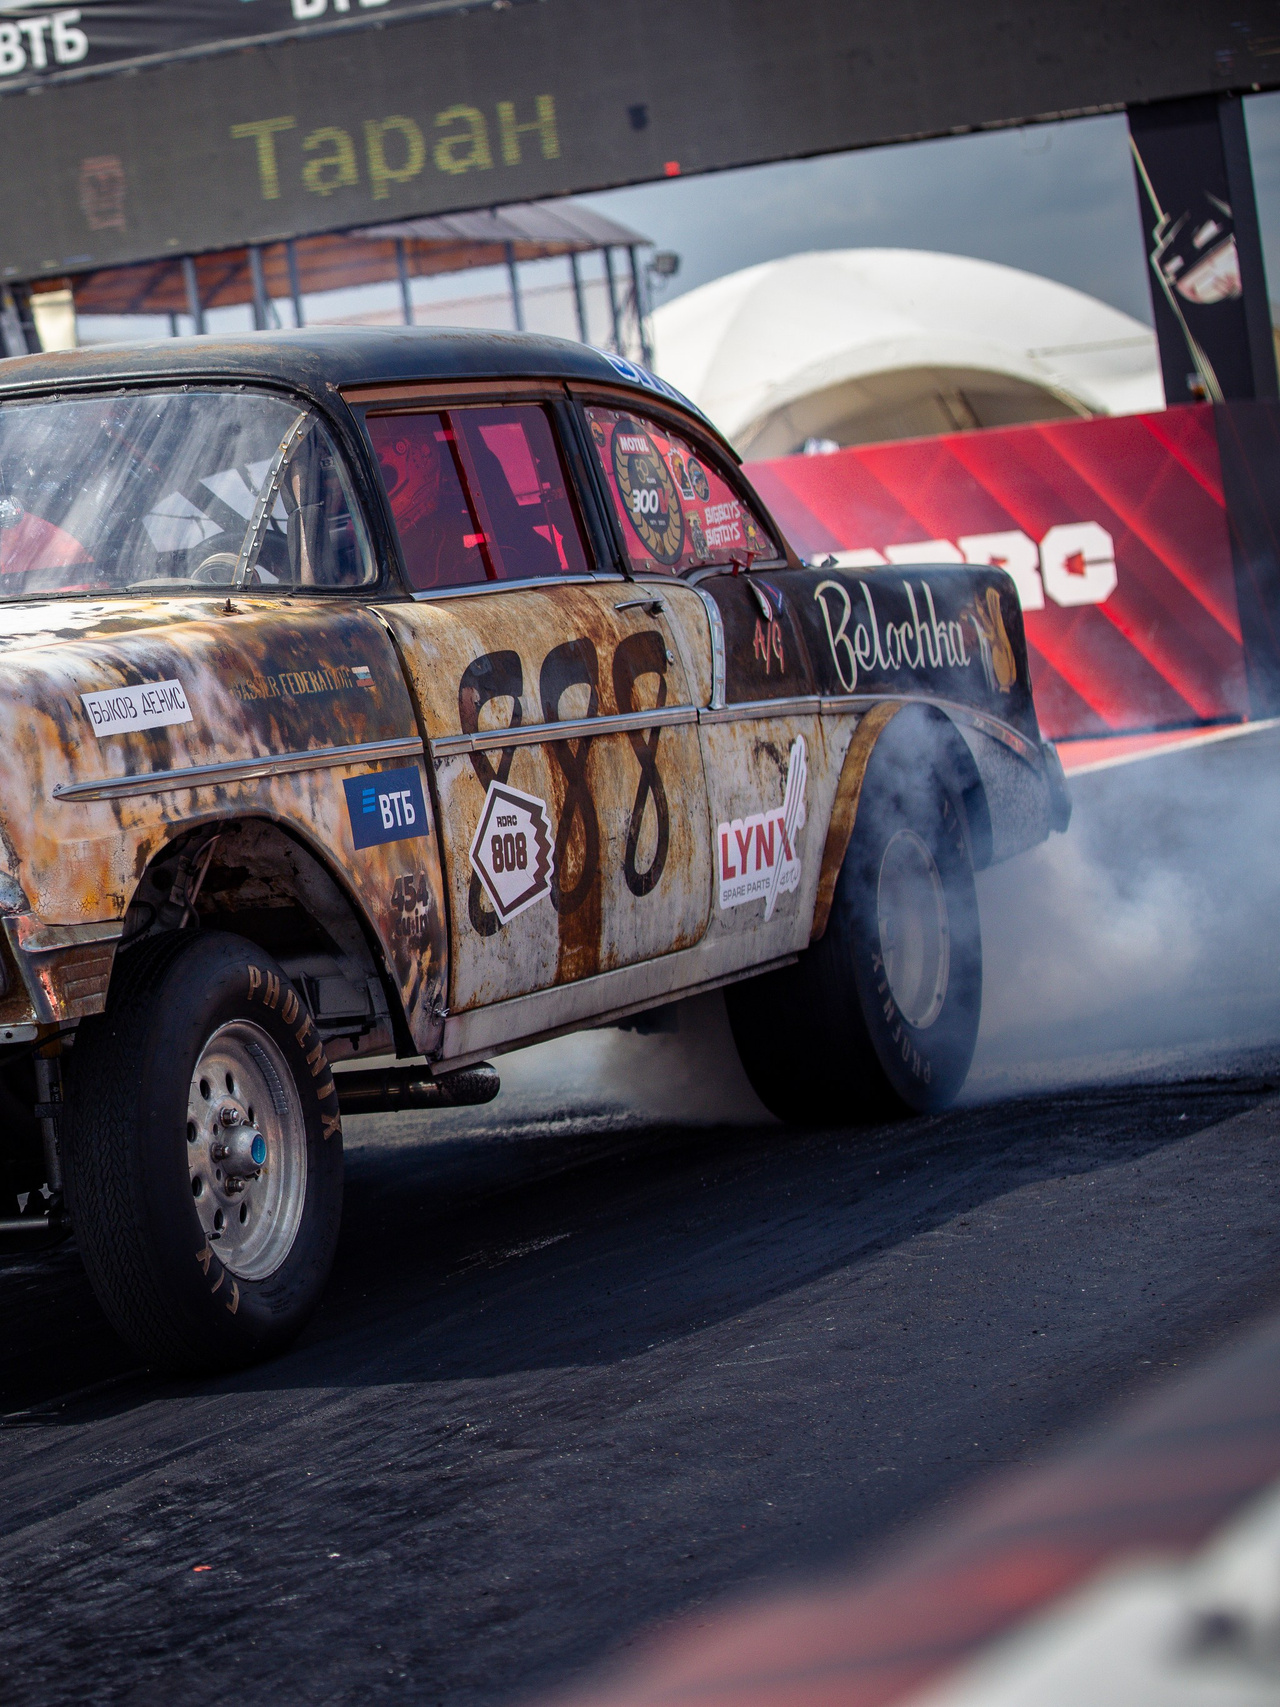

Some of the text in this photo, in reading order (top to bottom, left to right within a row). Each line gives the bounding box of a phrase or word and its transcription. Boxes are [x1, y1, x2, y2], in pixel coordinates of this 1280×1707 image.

[230, 95, 561, 201] Таран
[620, 437, 649, 452] MOTUL
[633, 488, 669, 514] 300V
[814, 580, 971, 692] Belochka
[88, 686, 186, 725] БЫКОВ ДЕНИС
[458, 630, 669, 937] 888
[378, 789, 416, 829] ВТБ
[496, 814, 518, 828] RDRC
[491, 832, 528, 874] 808
[721, 817, 793, 882] LYNX
[392, 872, 429, 912] 454
[723, 877, 771, 902] SPARE PARTS
